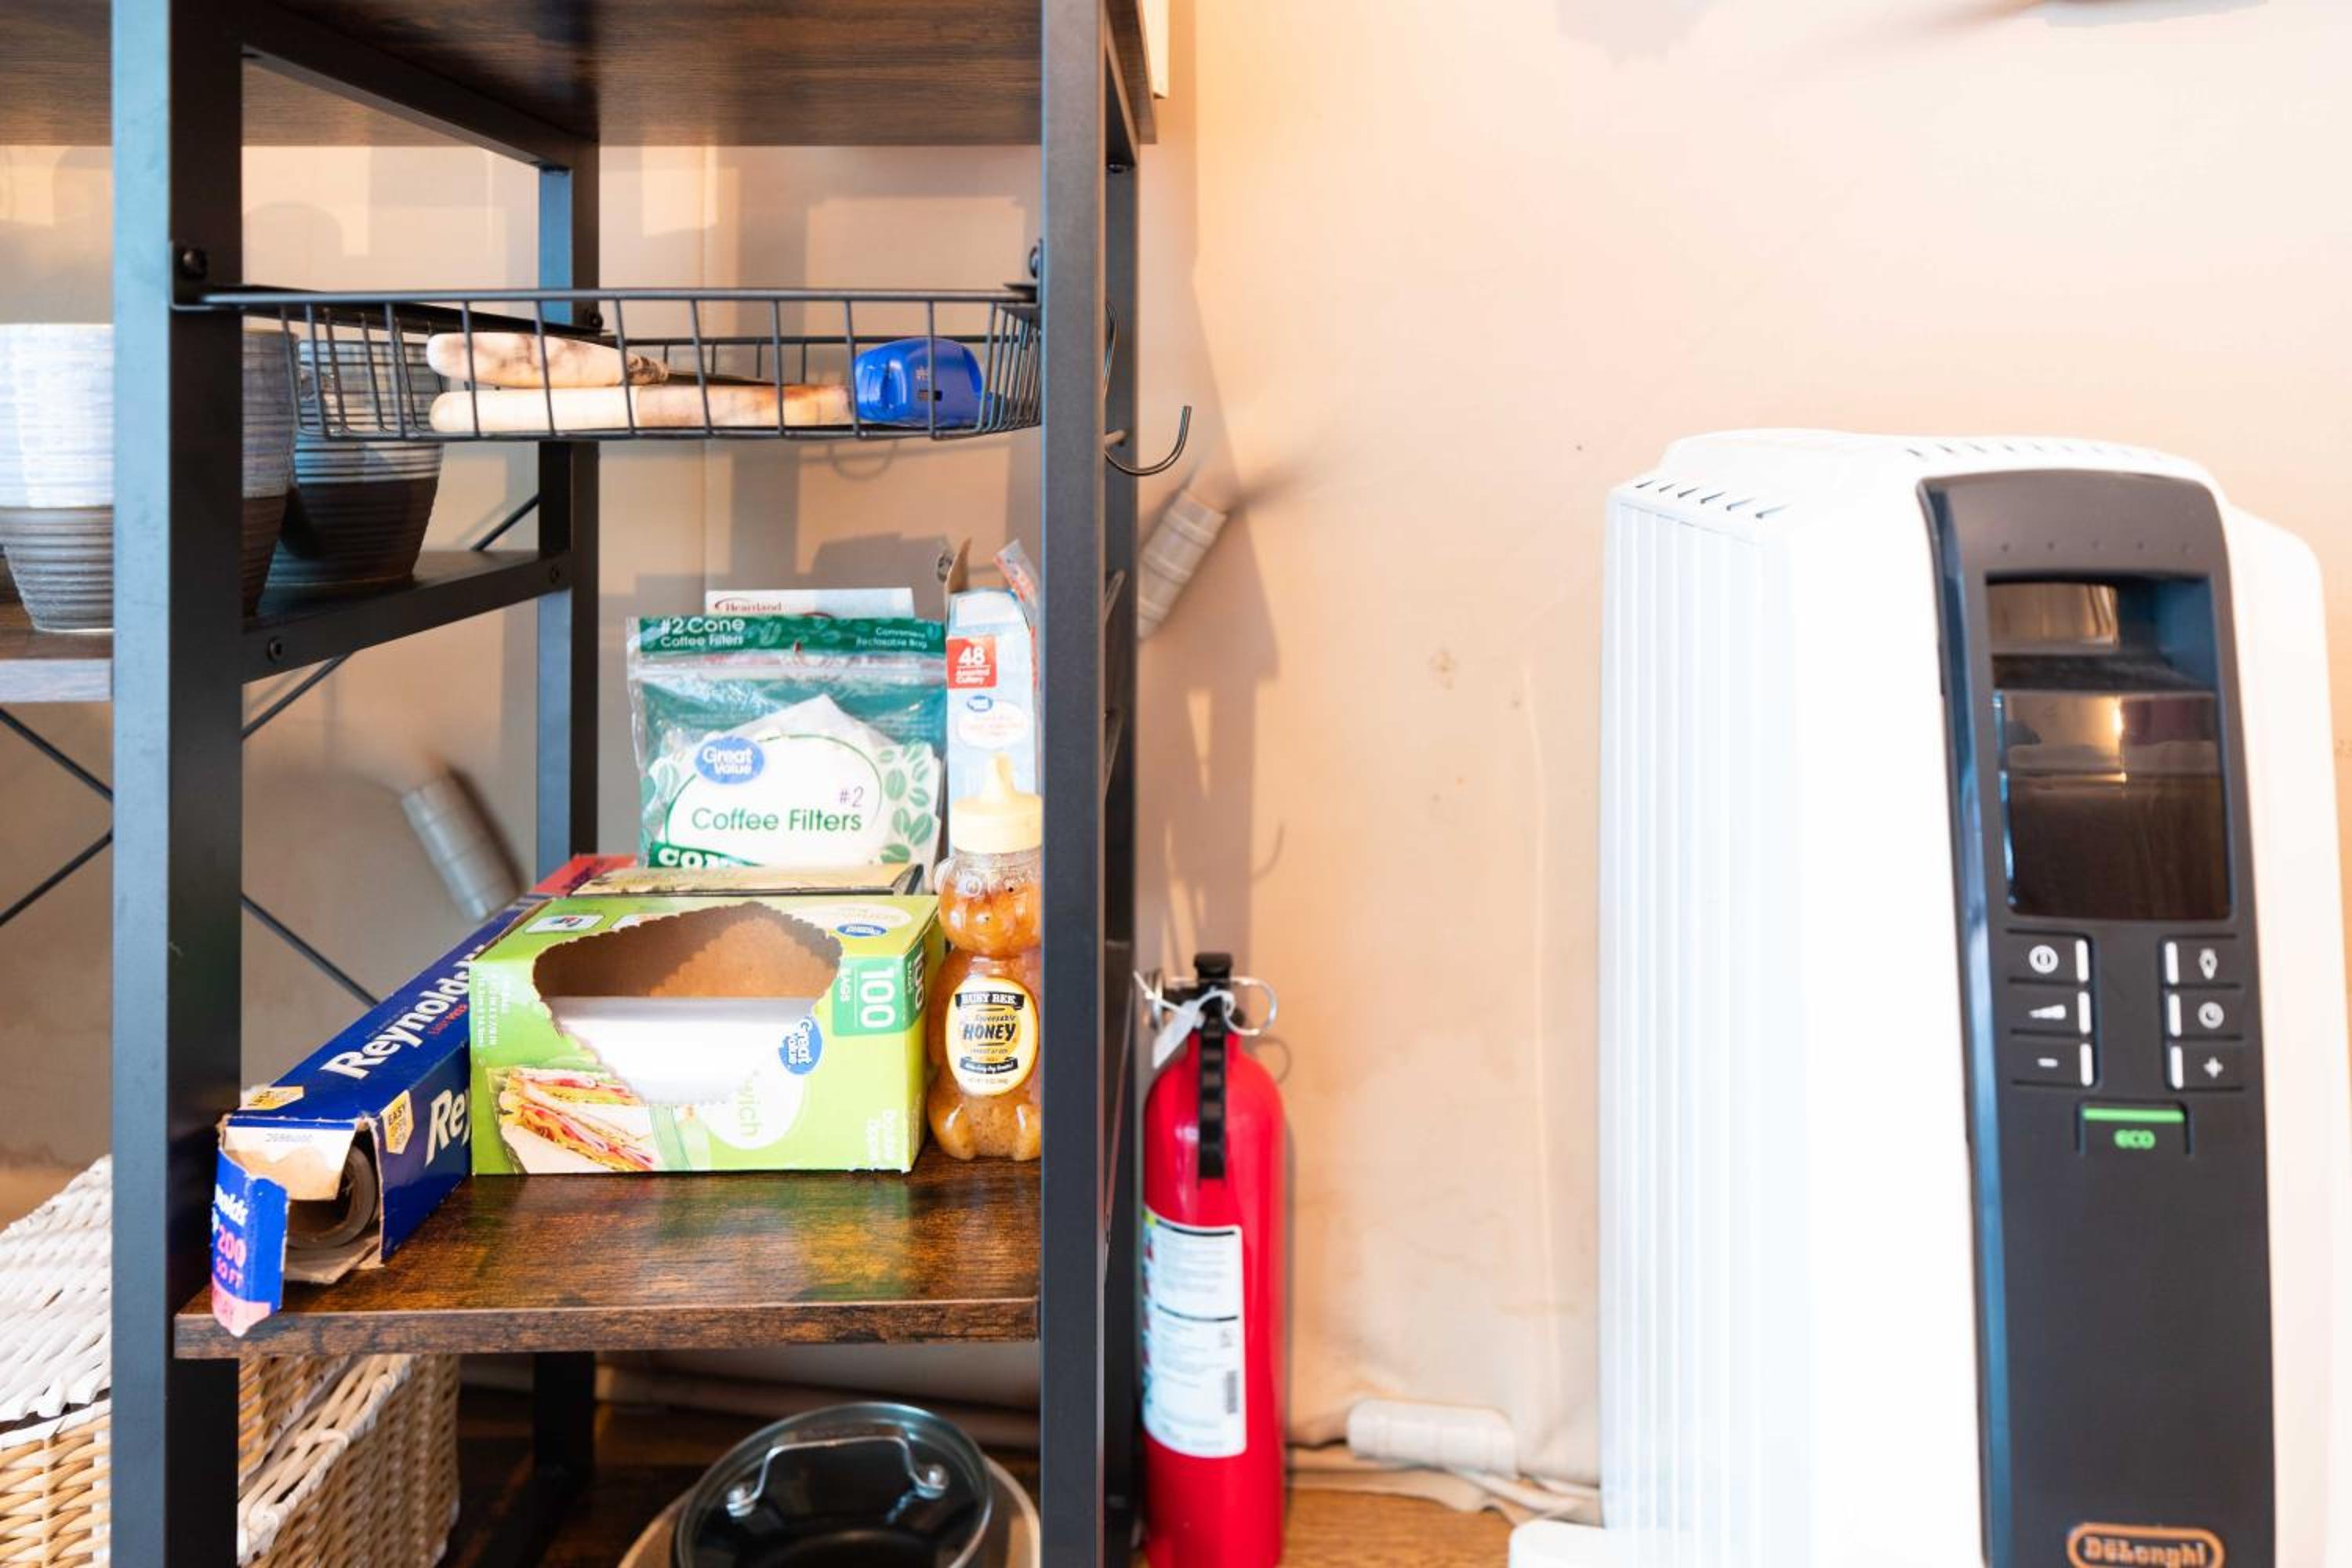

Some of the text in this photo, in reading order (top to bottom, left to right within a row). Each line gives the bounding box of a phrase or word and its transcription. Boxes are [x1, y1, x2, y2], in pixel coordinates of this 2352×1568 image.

[687, 617, 746, 633] Cone
[660, 633, 745, 648] Coffee Filters
[958, 646, 986, 665] 48
[702, 747, 753, 764] Great
[713, 763, 753, 775] Value
[839, 786, 864, 808] #2
[691, 807, 862, 831] Coffee Filters
[859, 967, 896, 1029] 100
[963, 1023, 1017, 1041] HONEY
[2114, 1128, 2156, 1149] eco
[218, 1224, 247, 1269] 200
